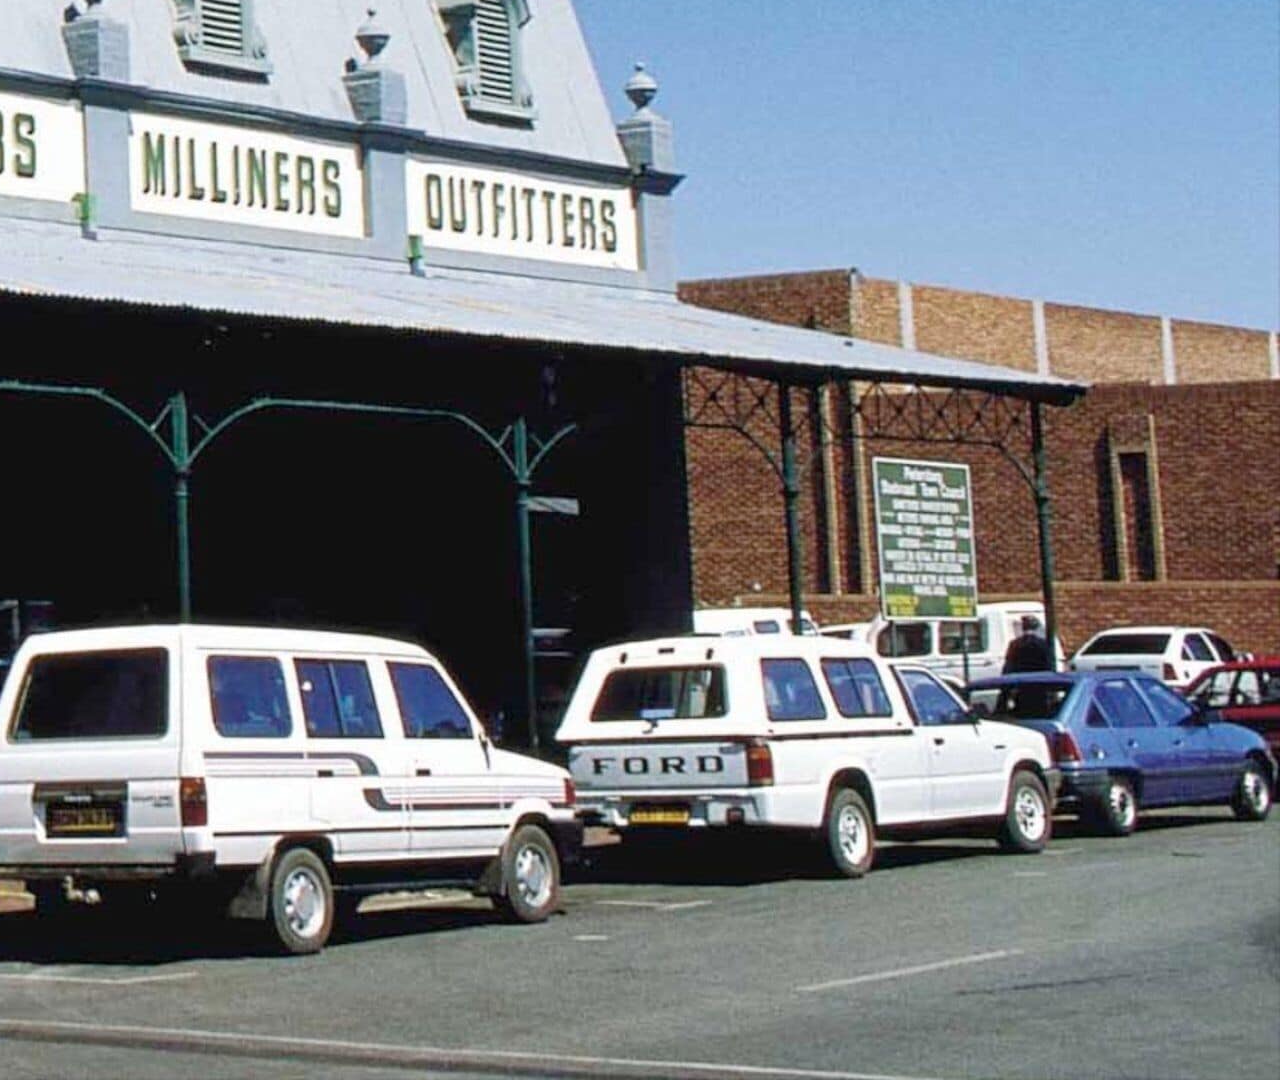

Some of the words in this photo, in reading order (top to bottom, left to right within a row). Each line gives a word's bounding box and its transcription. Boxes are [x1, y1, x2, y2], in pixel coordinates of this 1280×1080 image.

[142, 130, 342, 218] MILLINERS
[425, 173, 617, 253] OUTFITTERS
[592, 755, 724, 775] FORD
